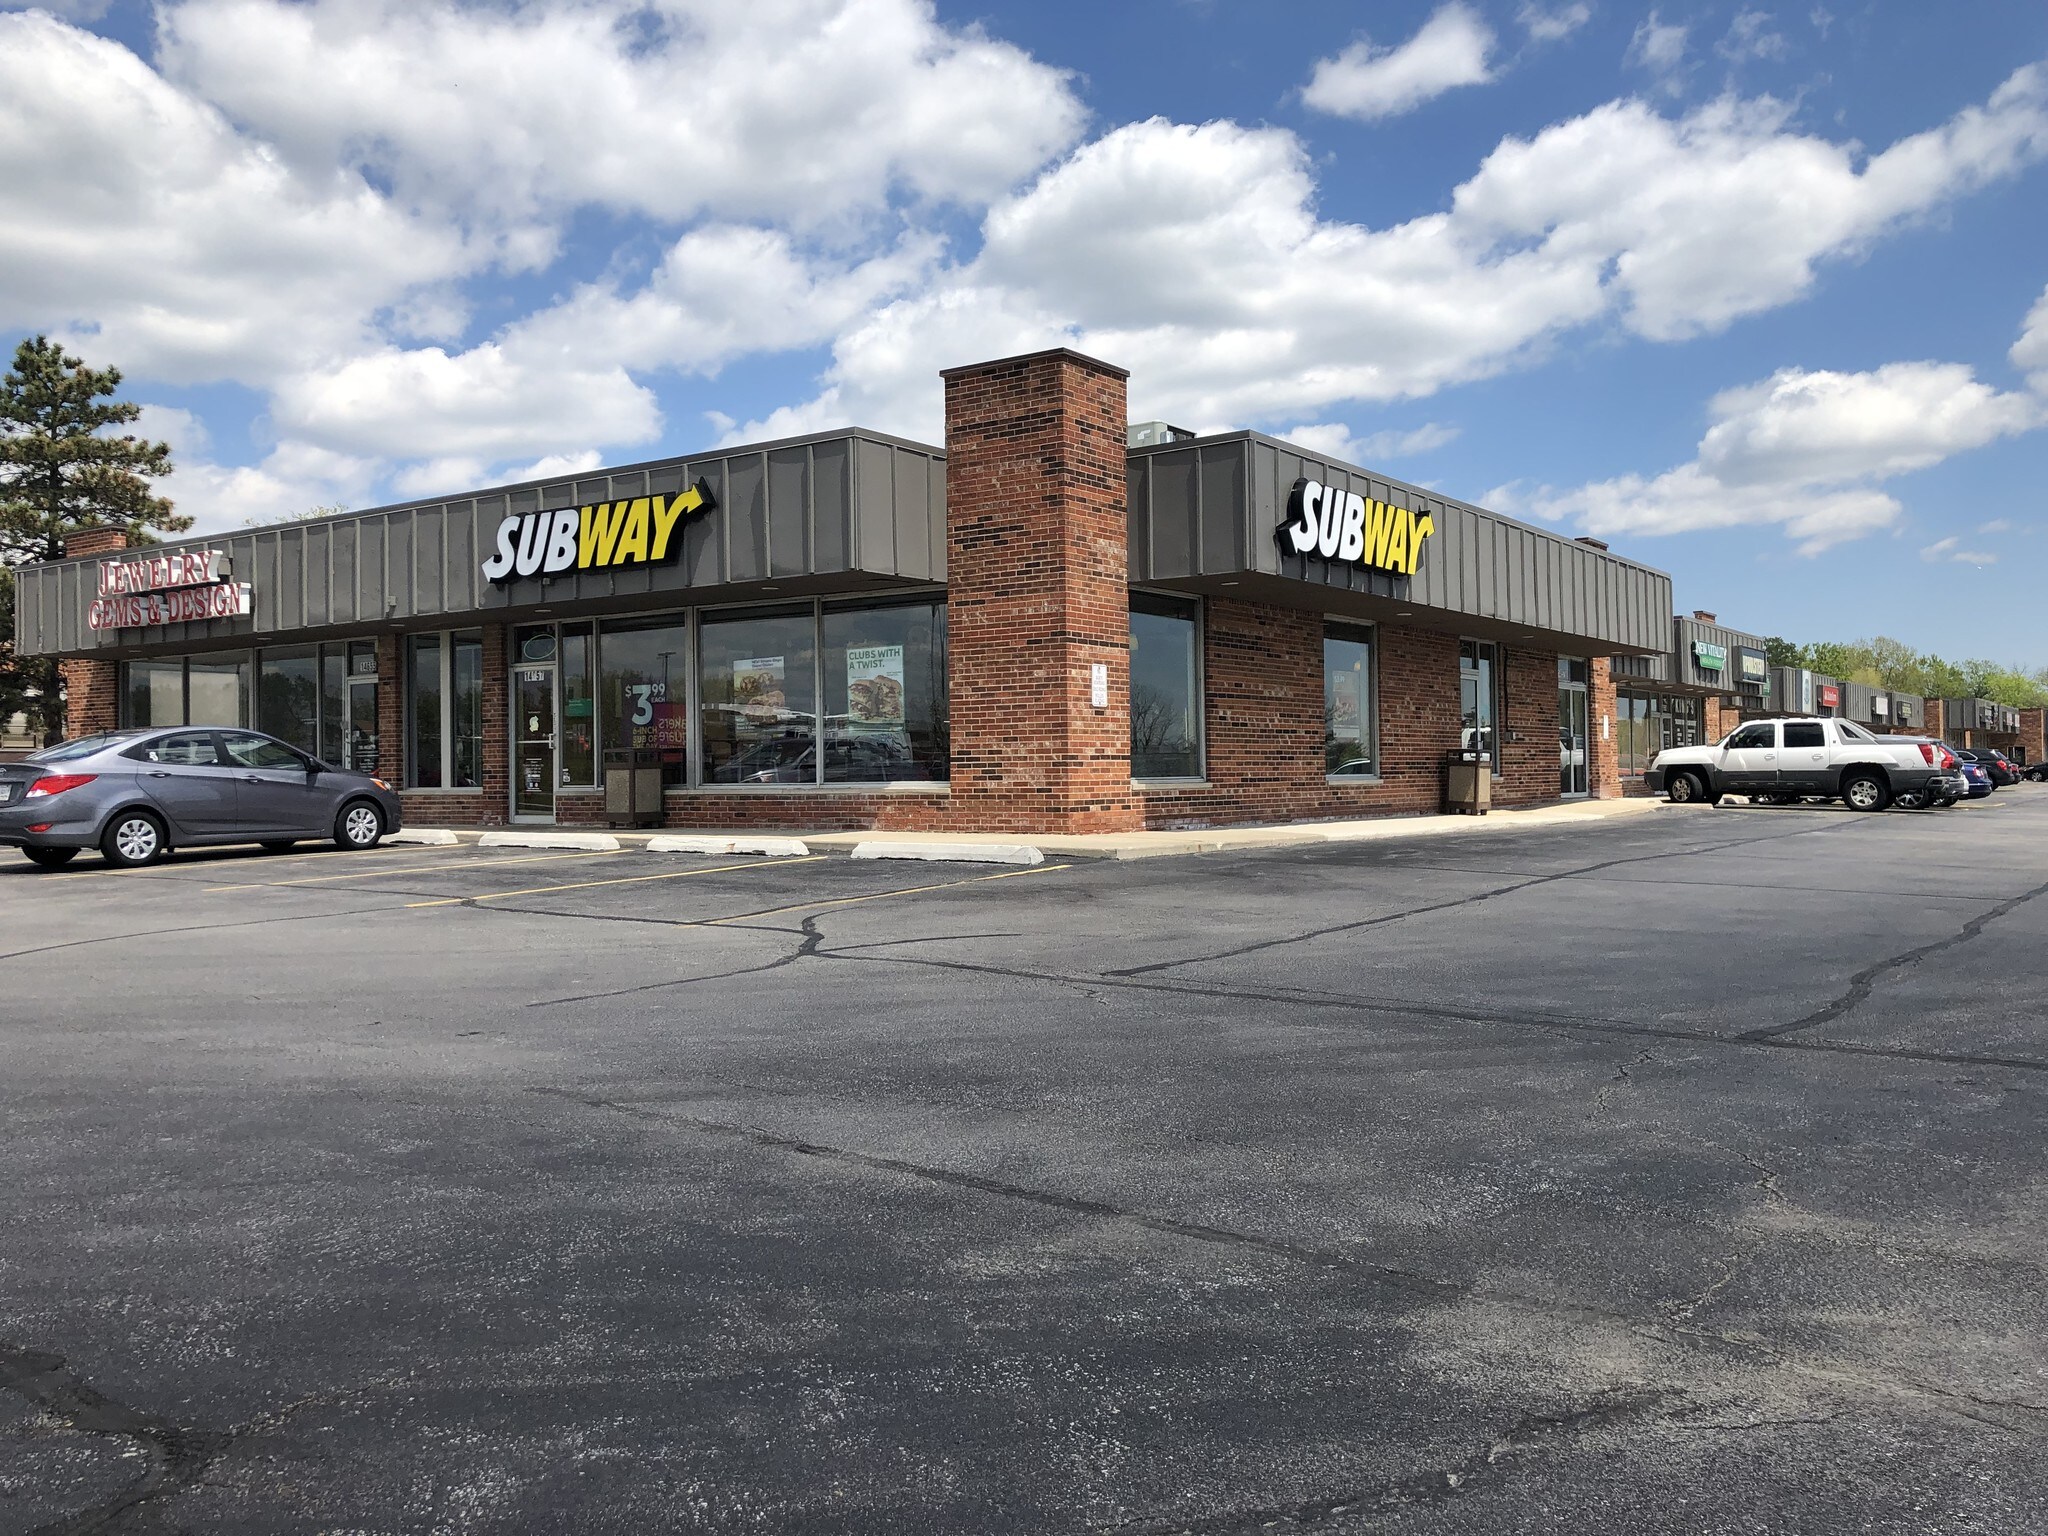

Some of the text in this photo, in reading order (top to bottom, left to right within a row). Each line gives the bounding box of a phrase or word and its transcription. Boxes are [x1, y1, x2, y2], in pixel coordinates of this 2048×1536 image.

[481, 484, 703, 583] SUBWAY
[1289, 481, 1435, 575] SUBWAY
[99, 550, 219, 597] JEWELRY
[89, 582, 246, 630] GEMS & DESIGN
[849, 648, 900, 660] CLUBS WITH
[849, 660, 885, 670] A TWIST.
[633, 726, 657, 735] 6-INCH
[633, 734, 658, 743] SUB OF
